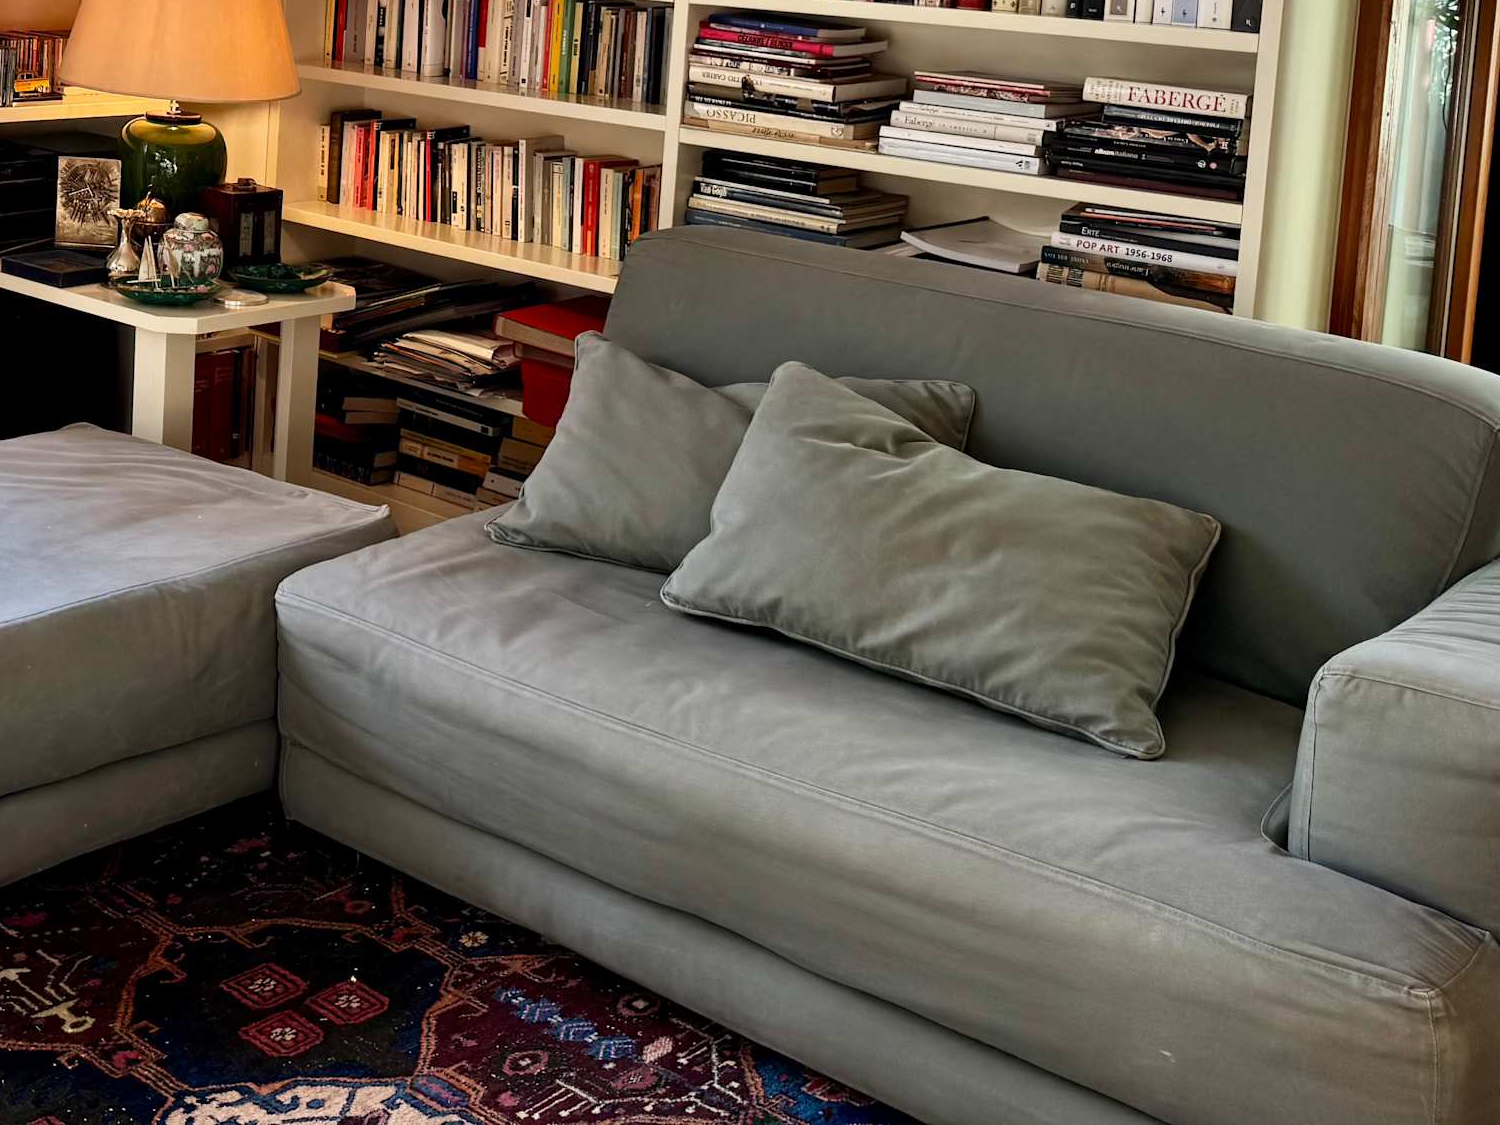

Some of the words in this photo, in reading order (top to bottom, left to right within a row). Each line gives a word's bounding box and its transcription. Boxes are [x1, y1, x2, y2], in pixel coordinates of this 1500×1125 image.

[1127, 86, 1227, 113] FABERGÉ
[706, 108, 756, 124] PICASSO
[711, 184, 728, 198] Gogh
[1076, 239, 1097, 251] POP
[1099, 243, 1120, 255] ART
[1124, 246, 1173, 264] 1956-1968
